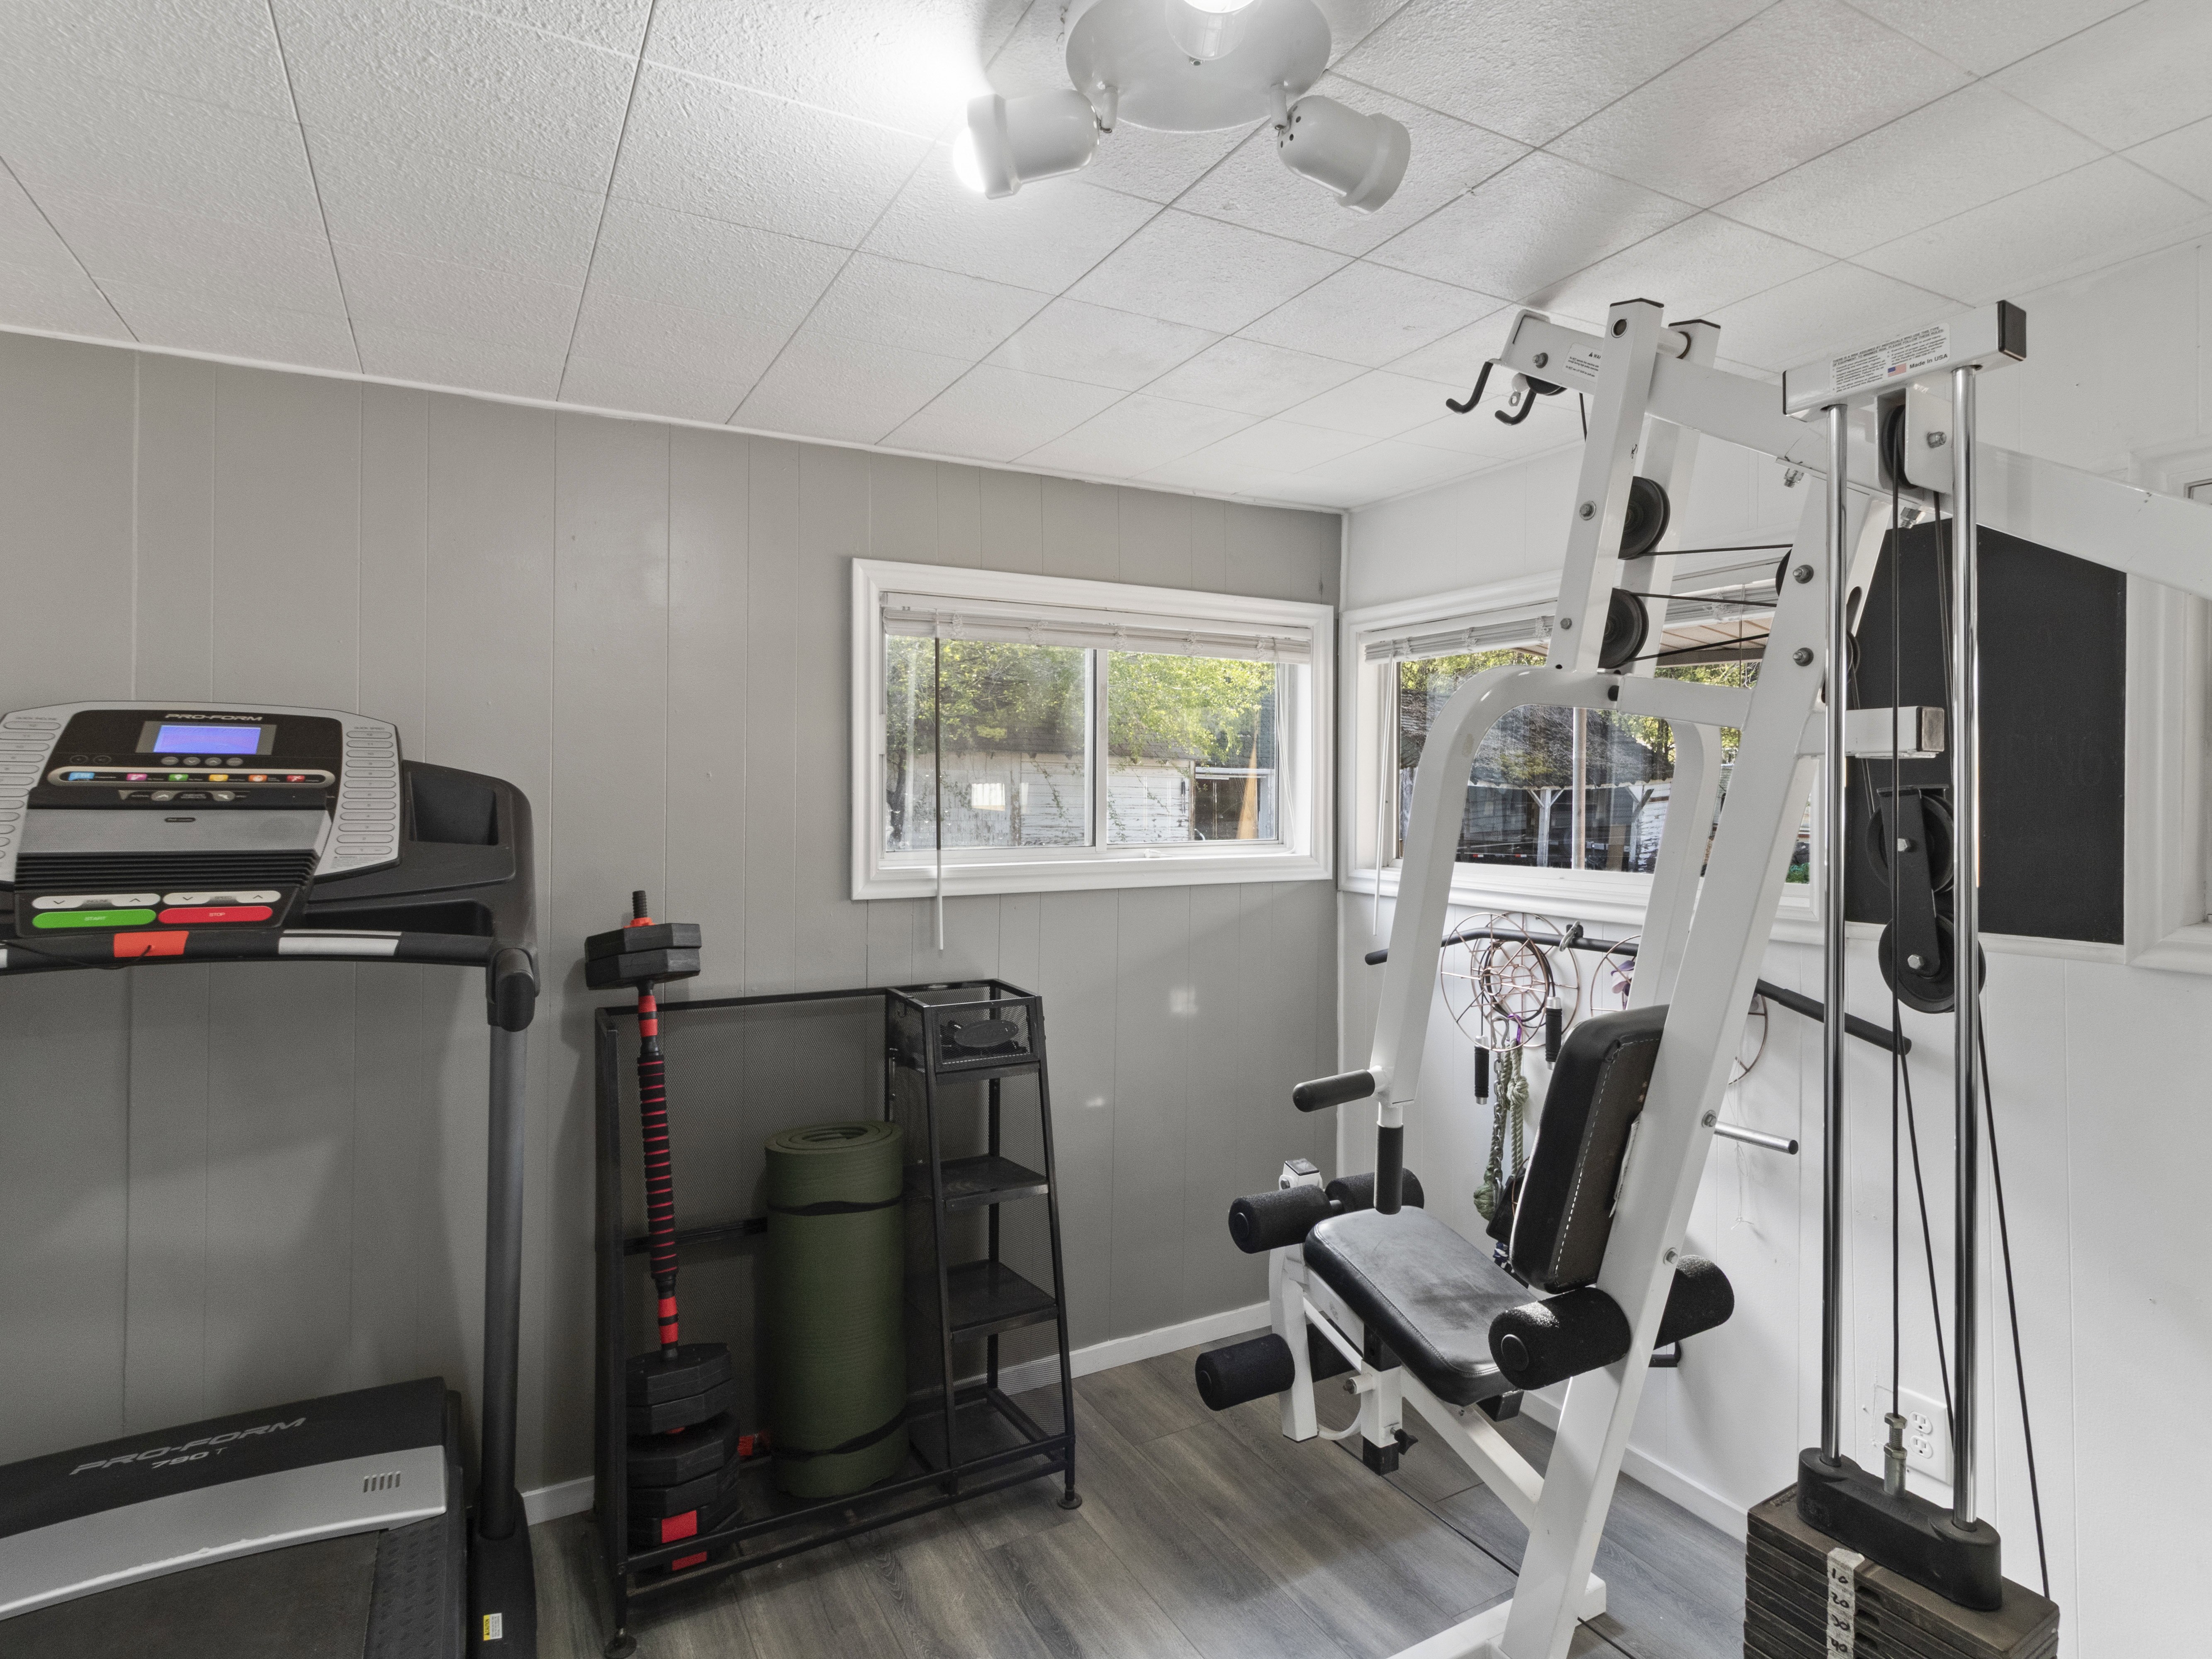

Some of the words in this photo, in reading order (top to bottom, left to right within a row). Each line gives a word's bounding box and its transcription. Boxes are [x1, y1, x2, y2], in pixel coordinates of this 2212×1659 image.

[1910, 360, 1925, 369] Made
[70, 1417, 307, 1475] PRO-FORM
[152, 1452, 209, 1469] 790
[1832, 1568, 1849, 1584] 10
[1831, 1591, 1849, 1608] 20
[1832, 1614, 1850, 1631] 30
[1830, 1636, 1848, 1653] 40
